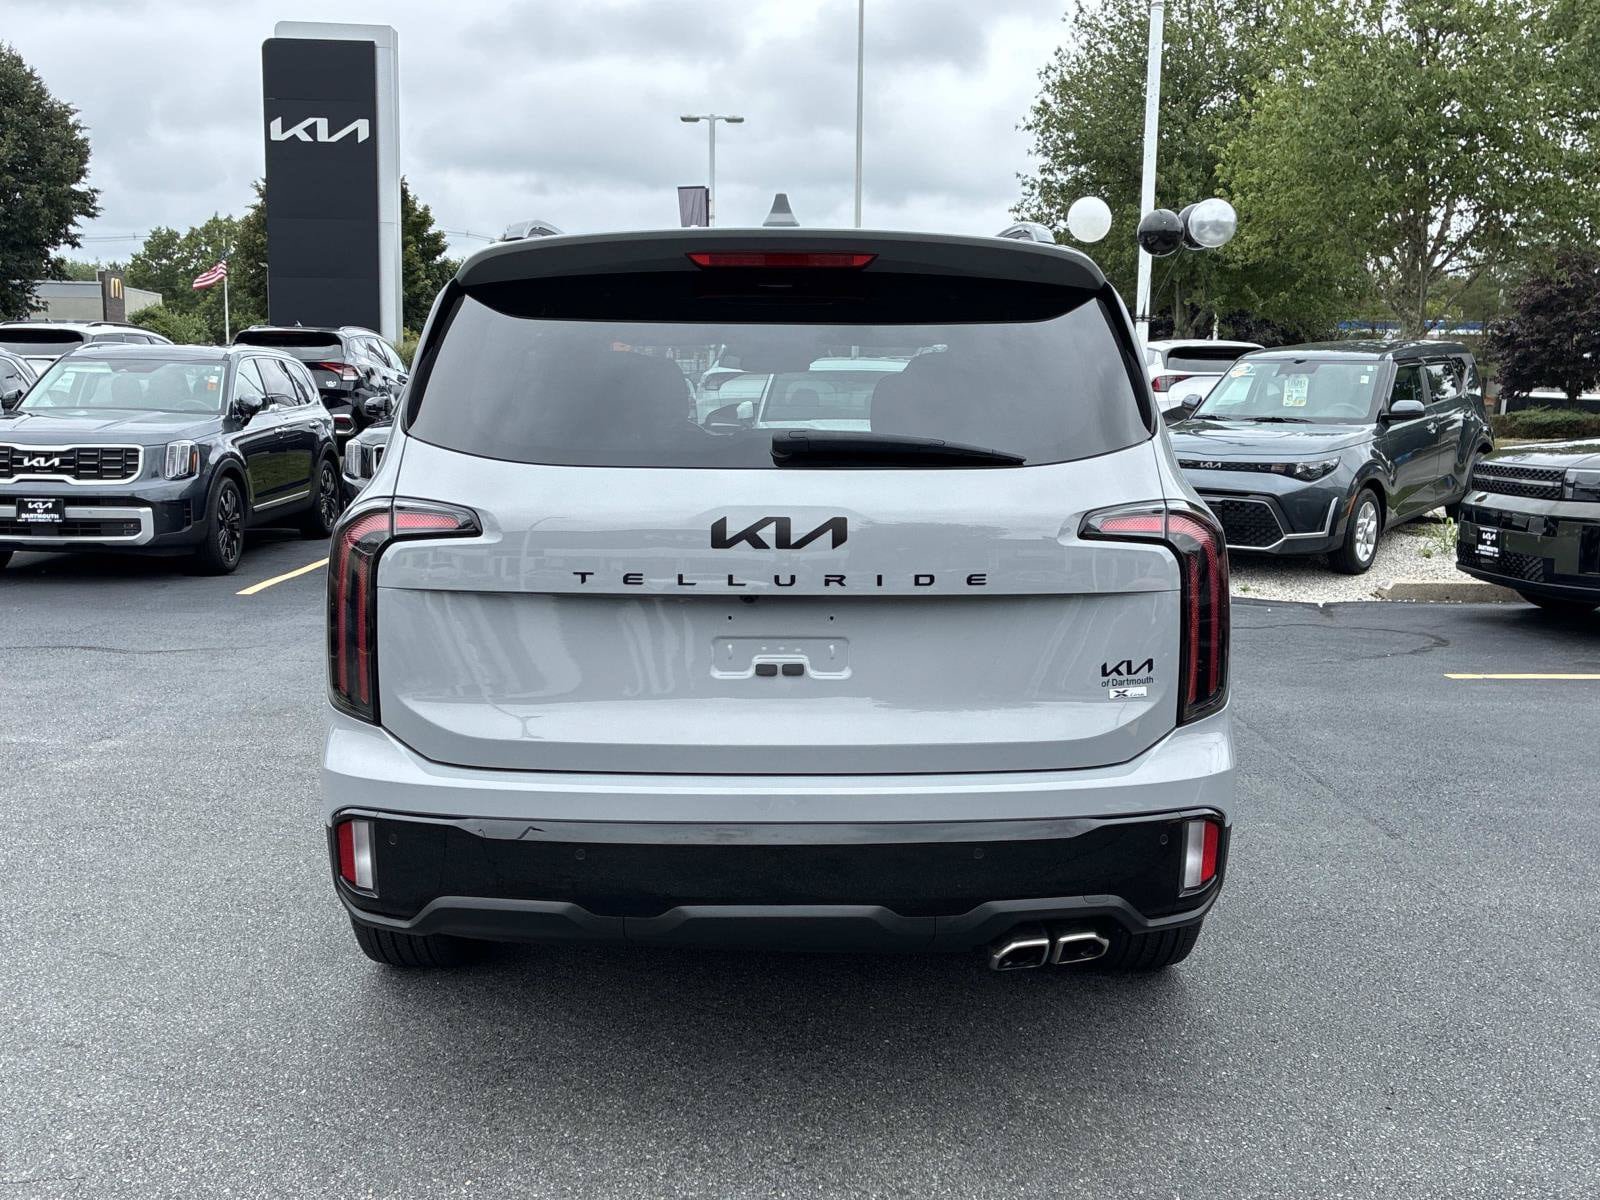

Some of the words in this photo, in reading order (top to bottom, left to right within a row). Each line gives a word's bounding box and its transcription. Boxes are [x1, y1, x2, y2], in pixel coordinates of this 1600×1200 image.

[270, 116, 369, 144] KIA
[23, 456, 60, 467] KIA
[711, 516, 848, 550] KIA
[573, 571, 988, 587] TELLURIDE
[1101, 658, 1154, 677] KIA
[1101, 679, 1110, 688] of
[1111, 676, 1154, 687] Dartmouth
